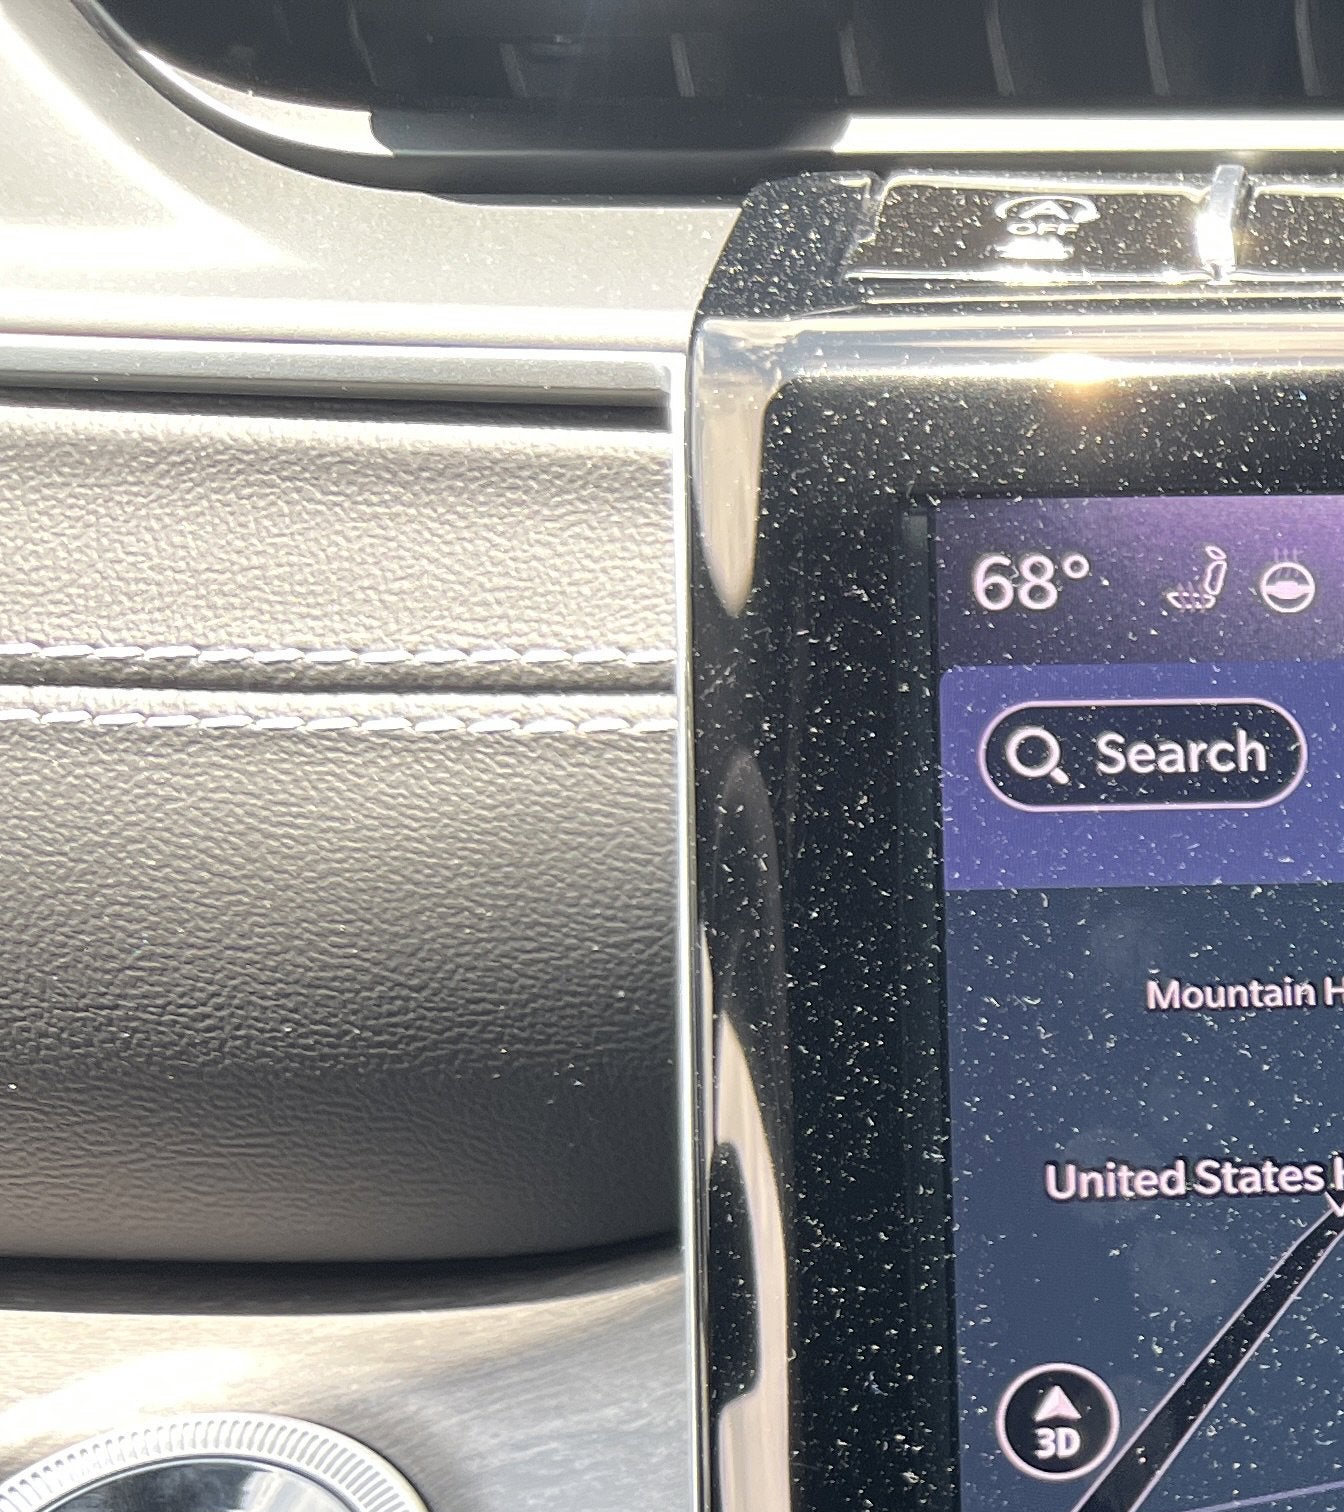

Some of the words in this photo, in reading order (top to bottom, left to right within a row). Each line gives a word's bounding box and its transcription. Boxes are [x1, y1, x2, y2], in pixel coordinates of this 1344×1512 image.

[1007, 222, 1080, 236] OFF
[972, 552, 1091, 613] 68°
[1096, 731, 1268, 775] Search
[1147, 976, 1316, 1011] Mountain
[1046, 1162, 1186, 1200] United
[1197, 1159, 1323, 1195] States
[1036, 1428, 1080, 1458] 3D
